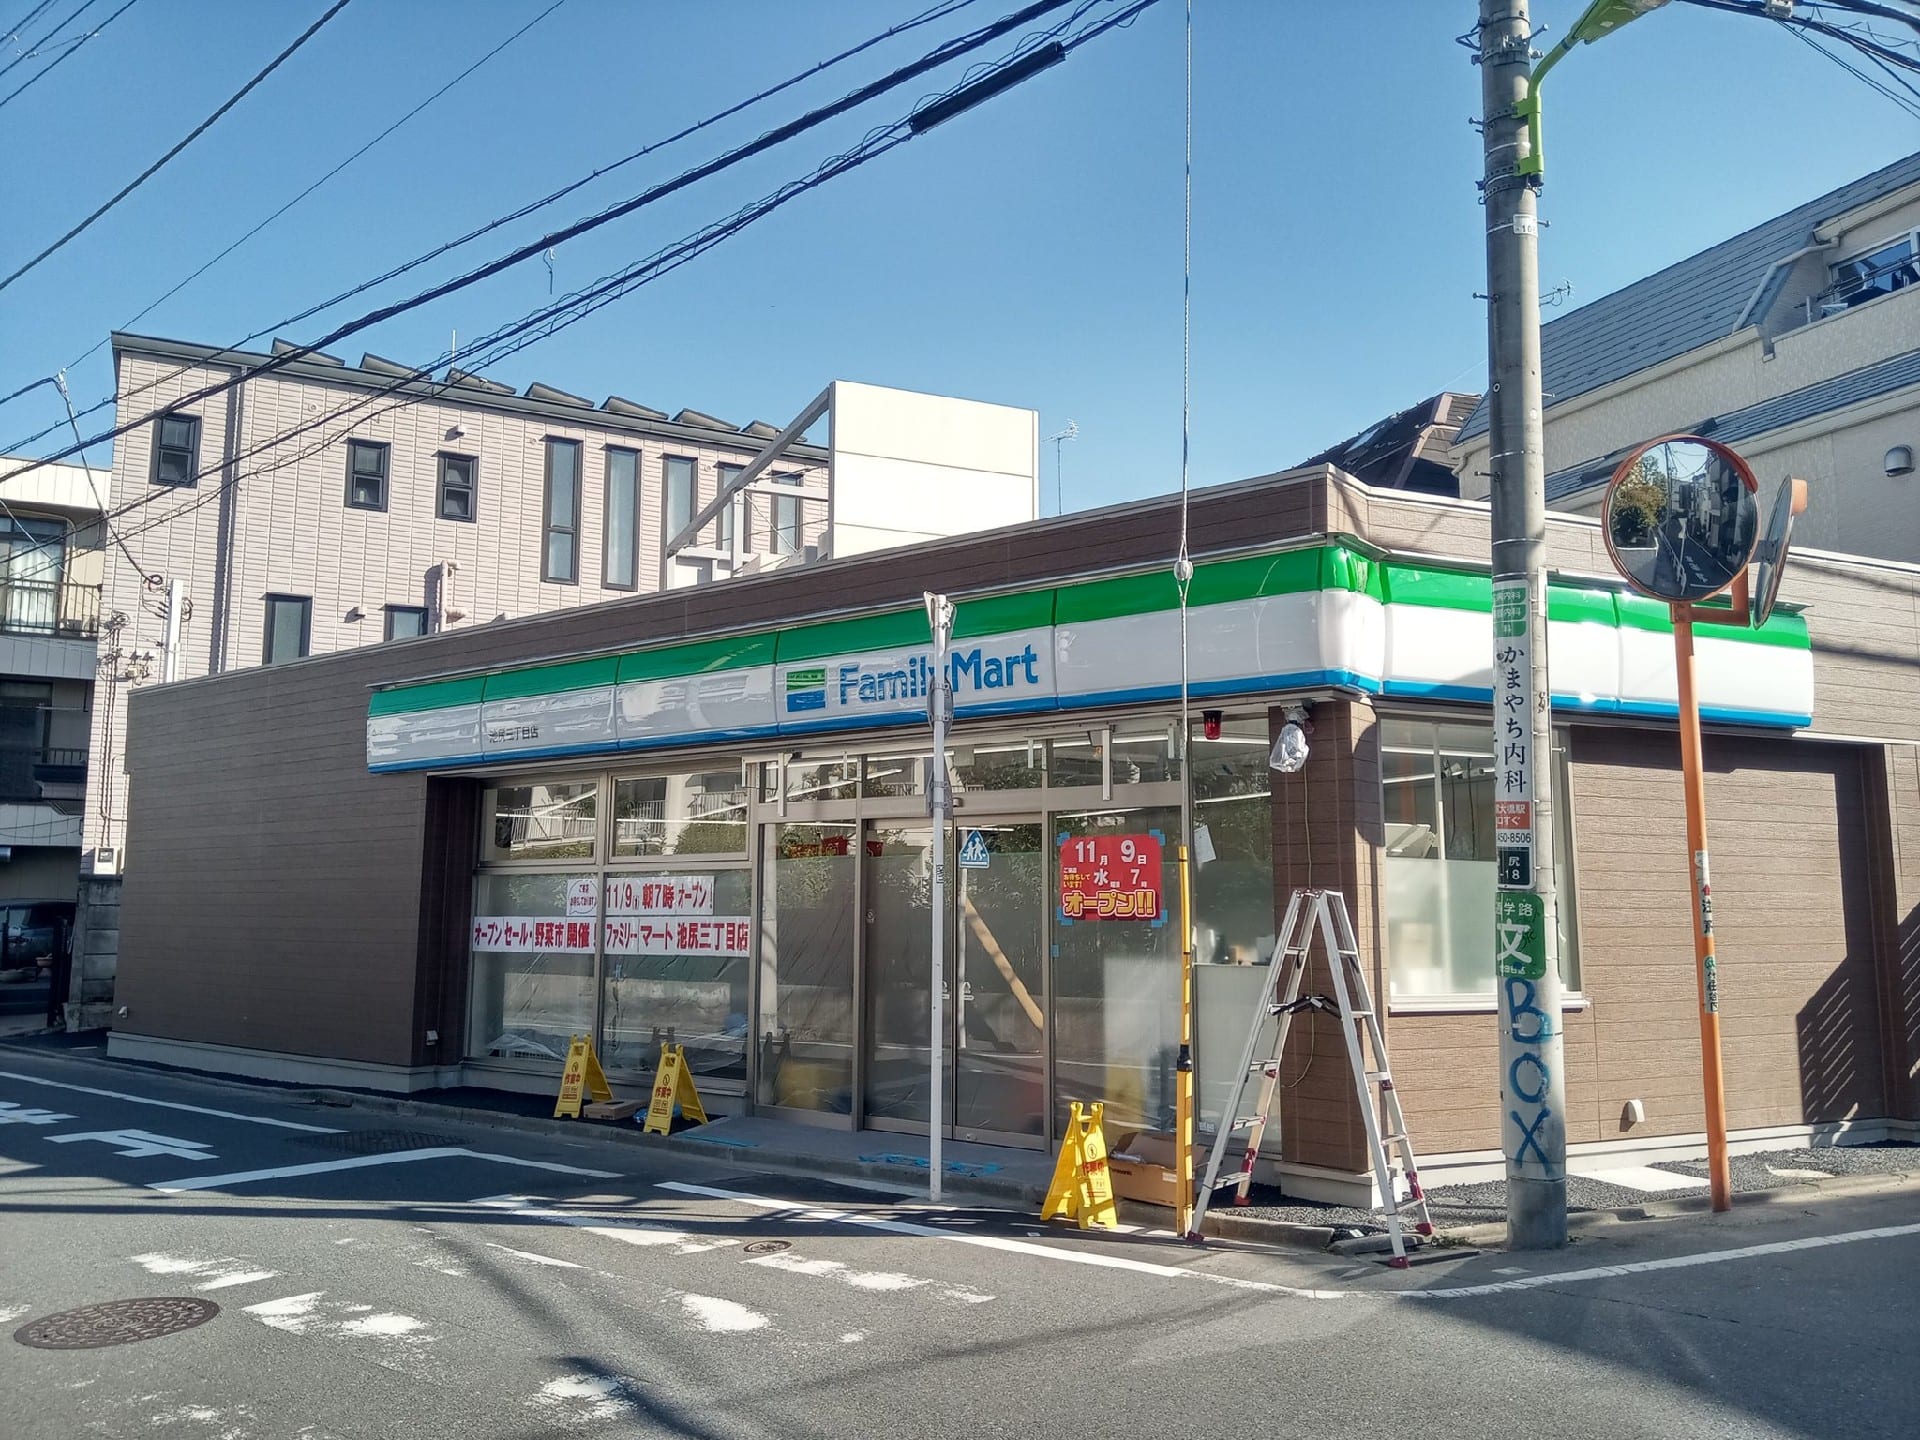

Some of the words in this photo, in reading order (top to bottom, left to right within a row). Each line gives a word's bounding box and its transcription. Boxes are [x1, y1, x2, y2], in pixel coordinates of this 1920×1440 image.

[1503, 646, 1527, 793] かまやち内科
